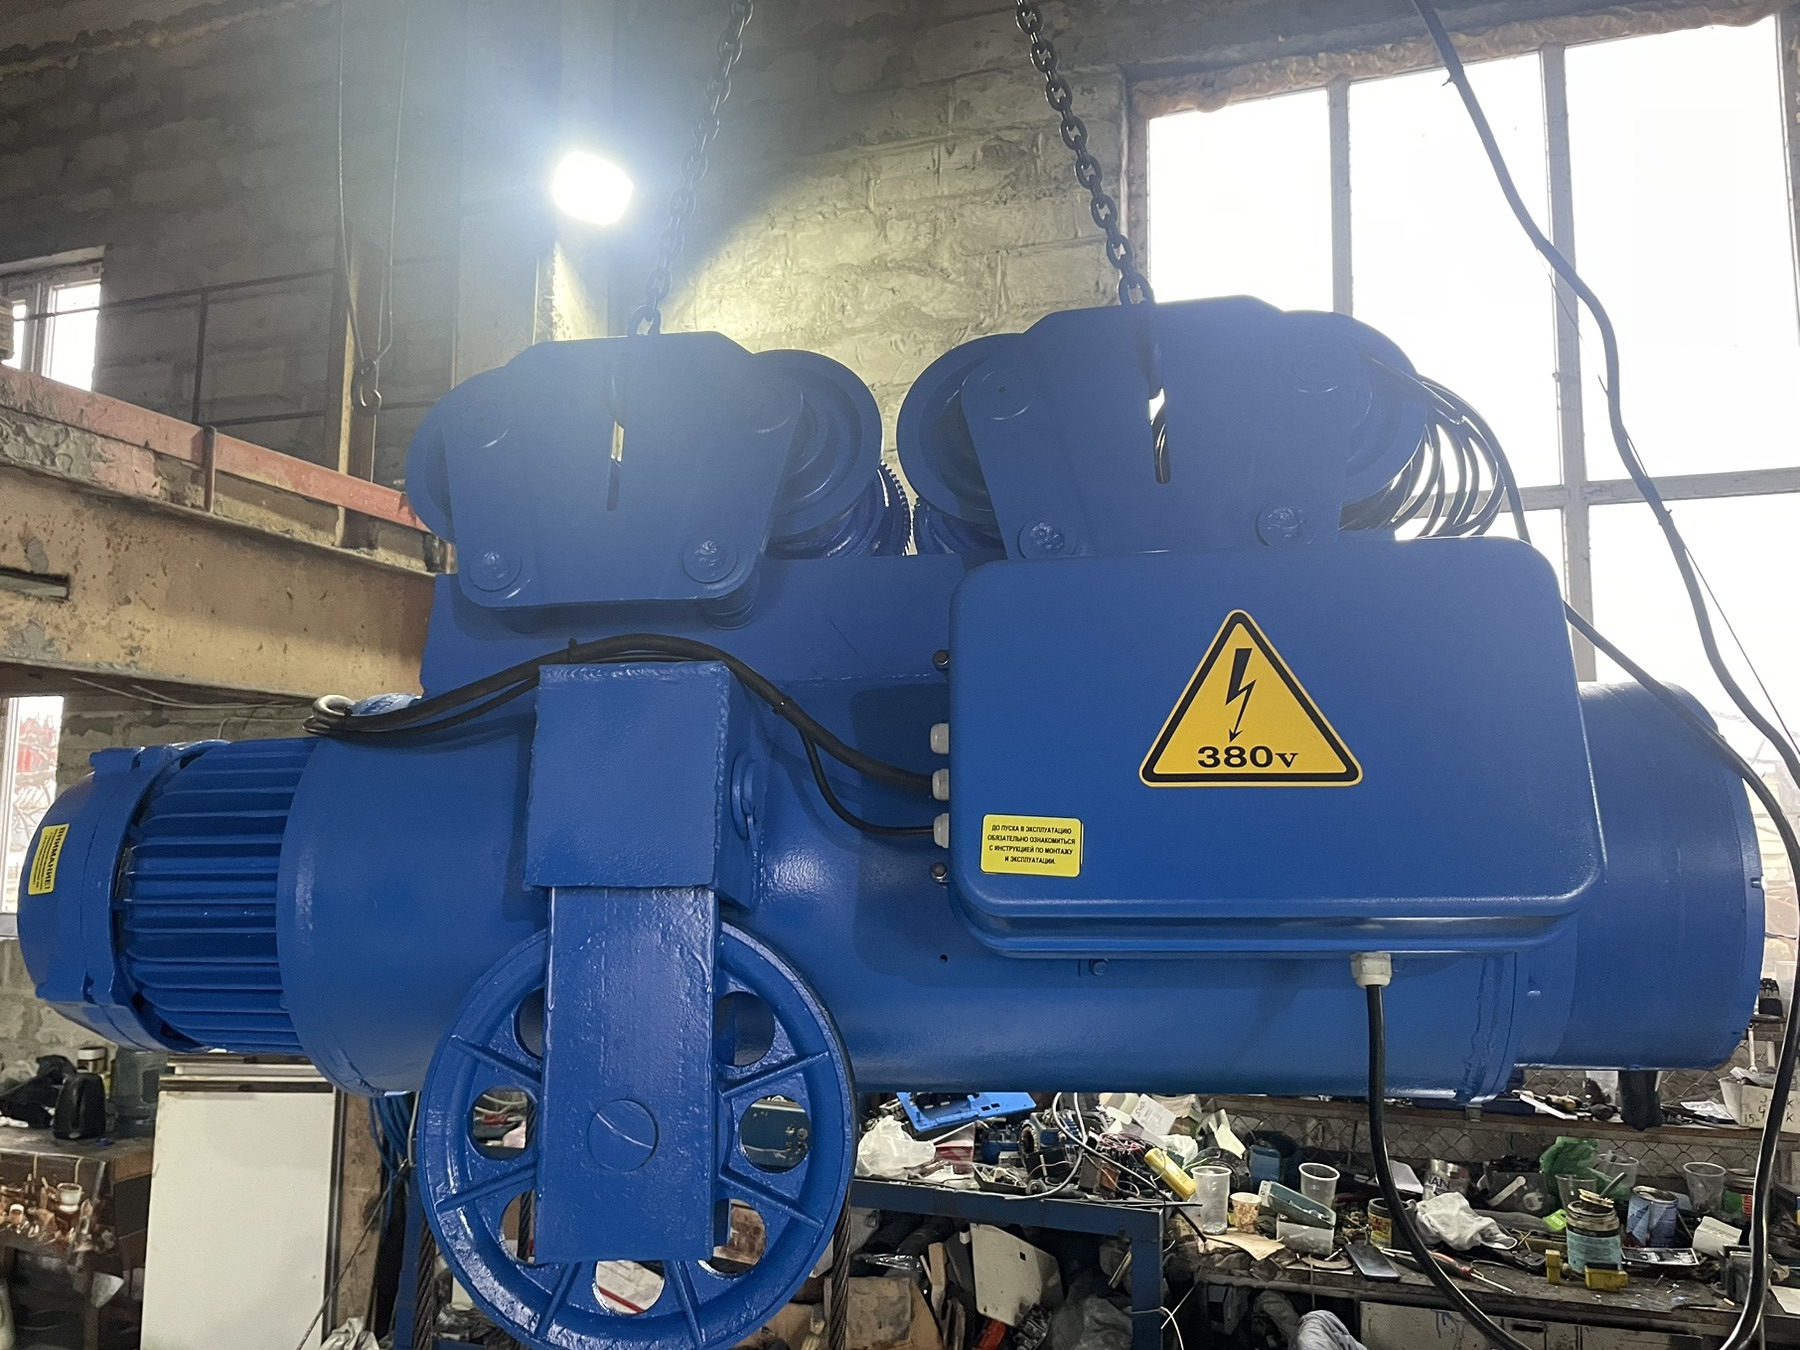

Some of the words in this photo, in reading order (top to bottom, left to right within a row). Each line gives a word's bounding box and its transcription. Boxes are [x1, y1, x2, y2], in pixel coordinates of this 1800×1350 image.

[1026, 826, 1072, 835] ЭКСПЛУАТАЦИЮ
[987, 835, 1029, 843] ОБЯЗАТЕЛЬНО
[1029, 836, 1076, 845] ОЗНАКОМИТЬСЯ
[994, 845, 1035, 854] ИНСТРУКЦИЕЙ
[1035, 846, 1044, 854] ПО
[1044, 847, 1073, 855] МОНТАЖУ
[44, 826, 66, 890] ВНИМАНИЕ!
[1010, 856, 1056, 865] ЭКСПЛУАТАЦИИ.
